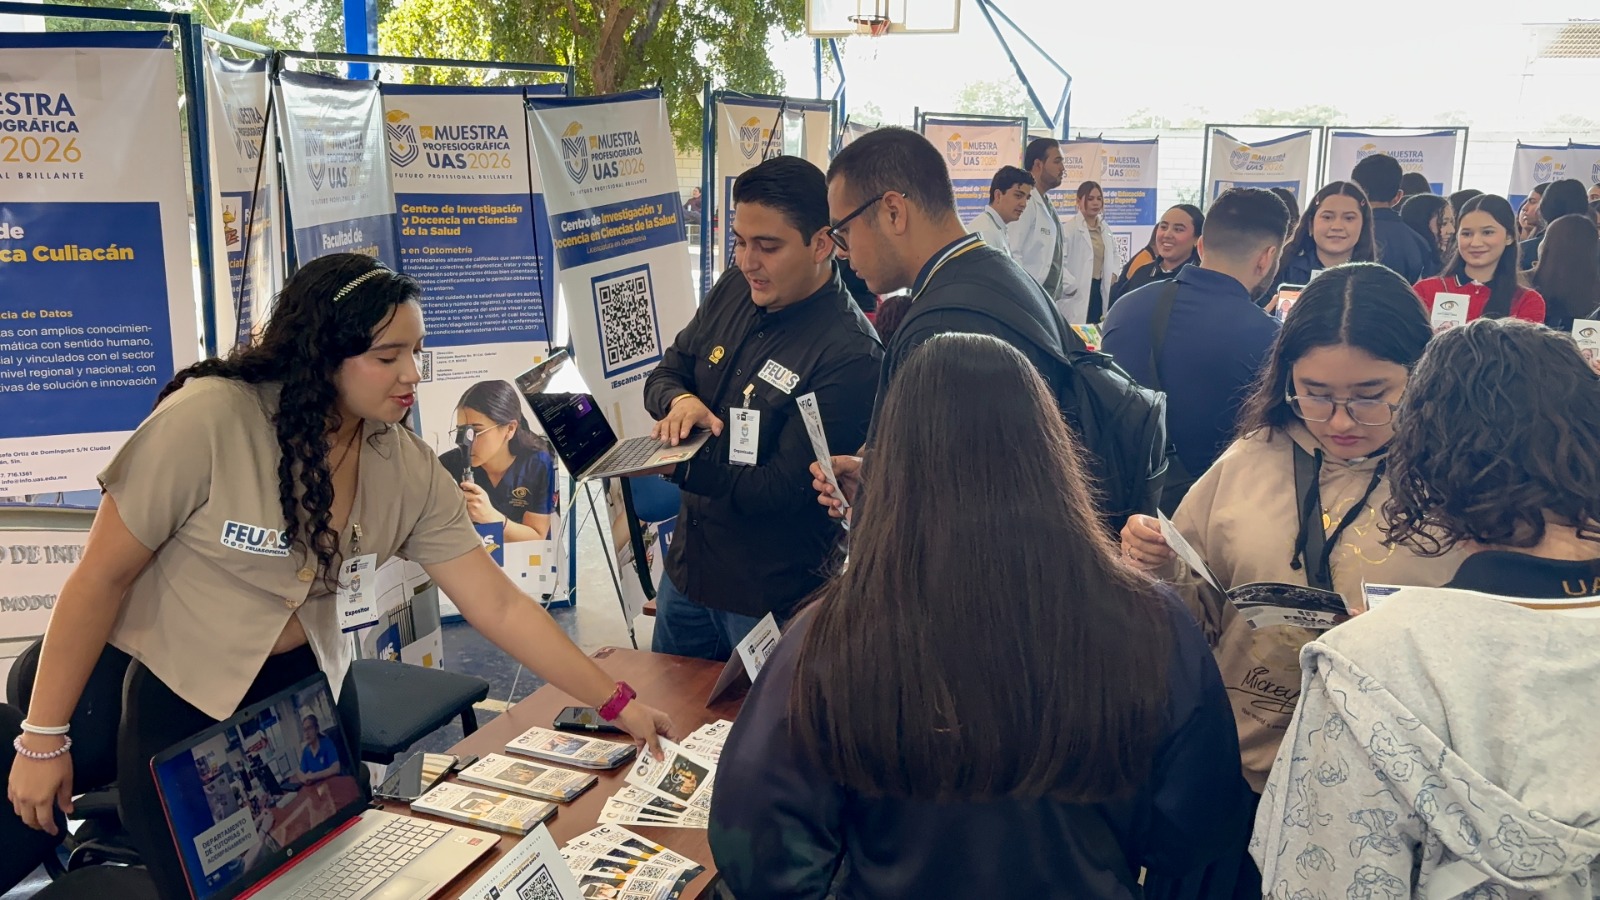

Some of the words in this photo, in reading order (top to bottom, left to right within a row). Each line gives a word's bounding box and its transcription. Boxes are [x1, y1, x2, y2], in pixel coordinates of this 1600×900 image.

[0, 118, 79, 133] GRÁFICA
[435, 125, 509, 141] MUESTRA
[422, 141, 511, 151] PROFESIOGRÁFICA
[598, 130, 641, 150] MUESTRA
[969, 142, 998, 150] MUESTRA
[1, 136, 82, 163] 2026
[591, 146, 643, 162] PROFESIOGRÁFICA
[1387, 150, 1424, 158] MUESTRA
[963, 156, 980, 166] UAS
[1113, 156, 1140, 164] MUESTRA
[1108, 169, 1124, 177] UAS
[1246, 163, 1264, 171] UAS
[18, 172, 84, 180] BRILLANTE
[328, 166, 348, 189] UAS
[402, 204, 439, 213] Centro
[441, 204, 455, 214] de
[457, 202, 523, 215] Investigación
[402, 216, 408, 226] y
[411, 215, 460, 225] Docencia
[462, 216, 476, 224] en
[477, 215, 518, 225] Ciencias
[561, 215, 591, 232] Centro
[590, 213, 601, 226] de
[601, 203, 654, 224] Investigación
[657, 203, 663, 214] y
[402, 227, 416, 236] de
[418, 226, 428, 236] la
[430, 226, 461, 236] Salud
[590, 230, 601, 240] en
[600, 224, 634, 240] Ciencias
[635, 220, 646, 232] de
[646, 217, 653, 229] la
[653, 213, 677, 227] Salud
[322, 228, 353, 249] Facultad
[353, 227, 363, 243] de
[621, 235, 647, 248] Optometría
[32, 244, 135, 262] Culiacán
[422, 246, 473, 256] Optometría
[21, 310, 36, 318] de
[40, 309, 73, 318] Datos
[17, 328, 38, 337] con
[41, 325, 84, 337] amplios
[86, 324, 152, 335] conocimien-
[41, 340, 61, 349] con
[64, 338, 104, 349] sentido
[16, 357, 23, 367] y
[25, 352, 85, 364] vinculados
[87, 352, 107, 361] con
[110, 351, 120, 360] el
[122, 350, 155, 359] sector
[1, 367, 27, 378] nivel
[29, 366, 74, 379] regional
[76, 367, 83, 377] y
[136, 364, 156, 373] con
[26, 380, 41, 390] de
[43, 379, 89, 391] solución
[91, 380, 98, 388] e
[100, 376, 157, 387] innovación
[611, 373, 642, 389] ¡Escanea
[225, 522, 291, 550] FEUAS
[9, 544, 42, 565] DE
[345, 606, 370, 618] Expositor
[202, 817, 247, 850] DEPARTAMENTO
[590, 827, 611, 838] FIC
[204, 847, 214, 857] DE
